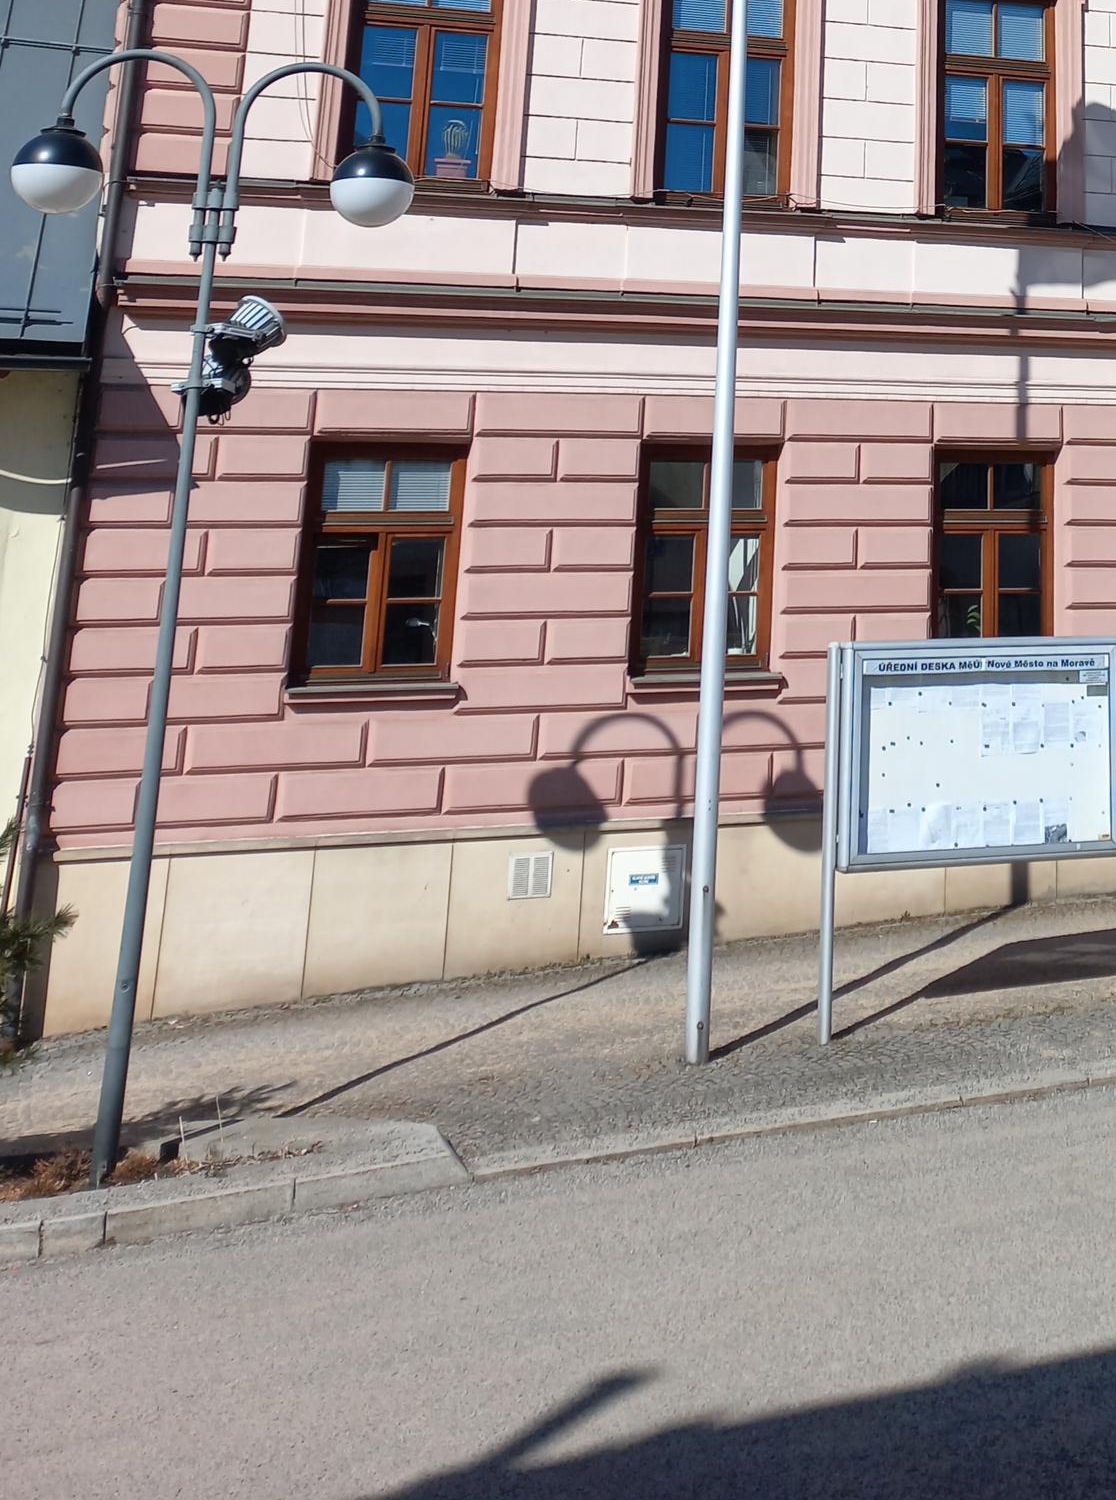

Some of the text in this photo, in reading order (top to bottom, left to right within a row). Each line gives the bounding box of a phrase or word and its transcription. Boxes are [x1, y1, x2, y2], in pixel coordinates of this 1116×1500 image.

[879, 661, 918, 672] ÚŘEDNÍ
[921, 662, 956, 671] DESKA
[987, 659, 1011, 668] Nové
[1014, 658, 1044, 668] Město
[1046, 660, 1059, 668] na
[1061, 658, 1095, 668] Moravě
